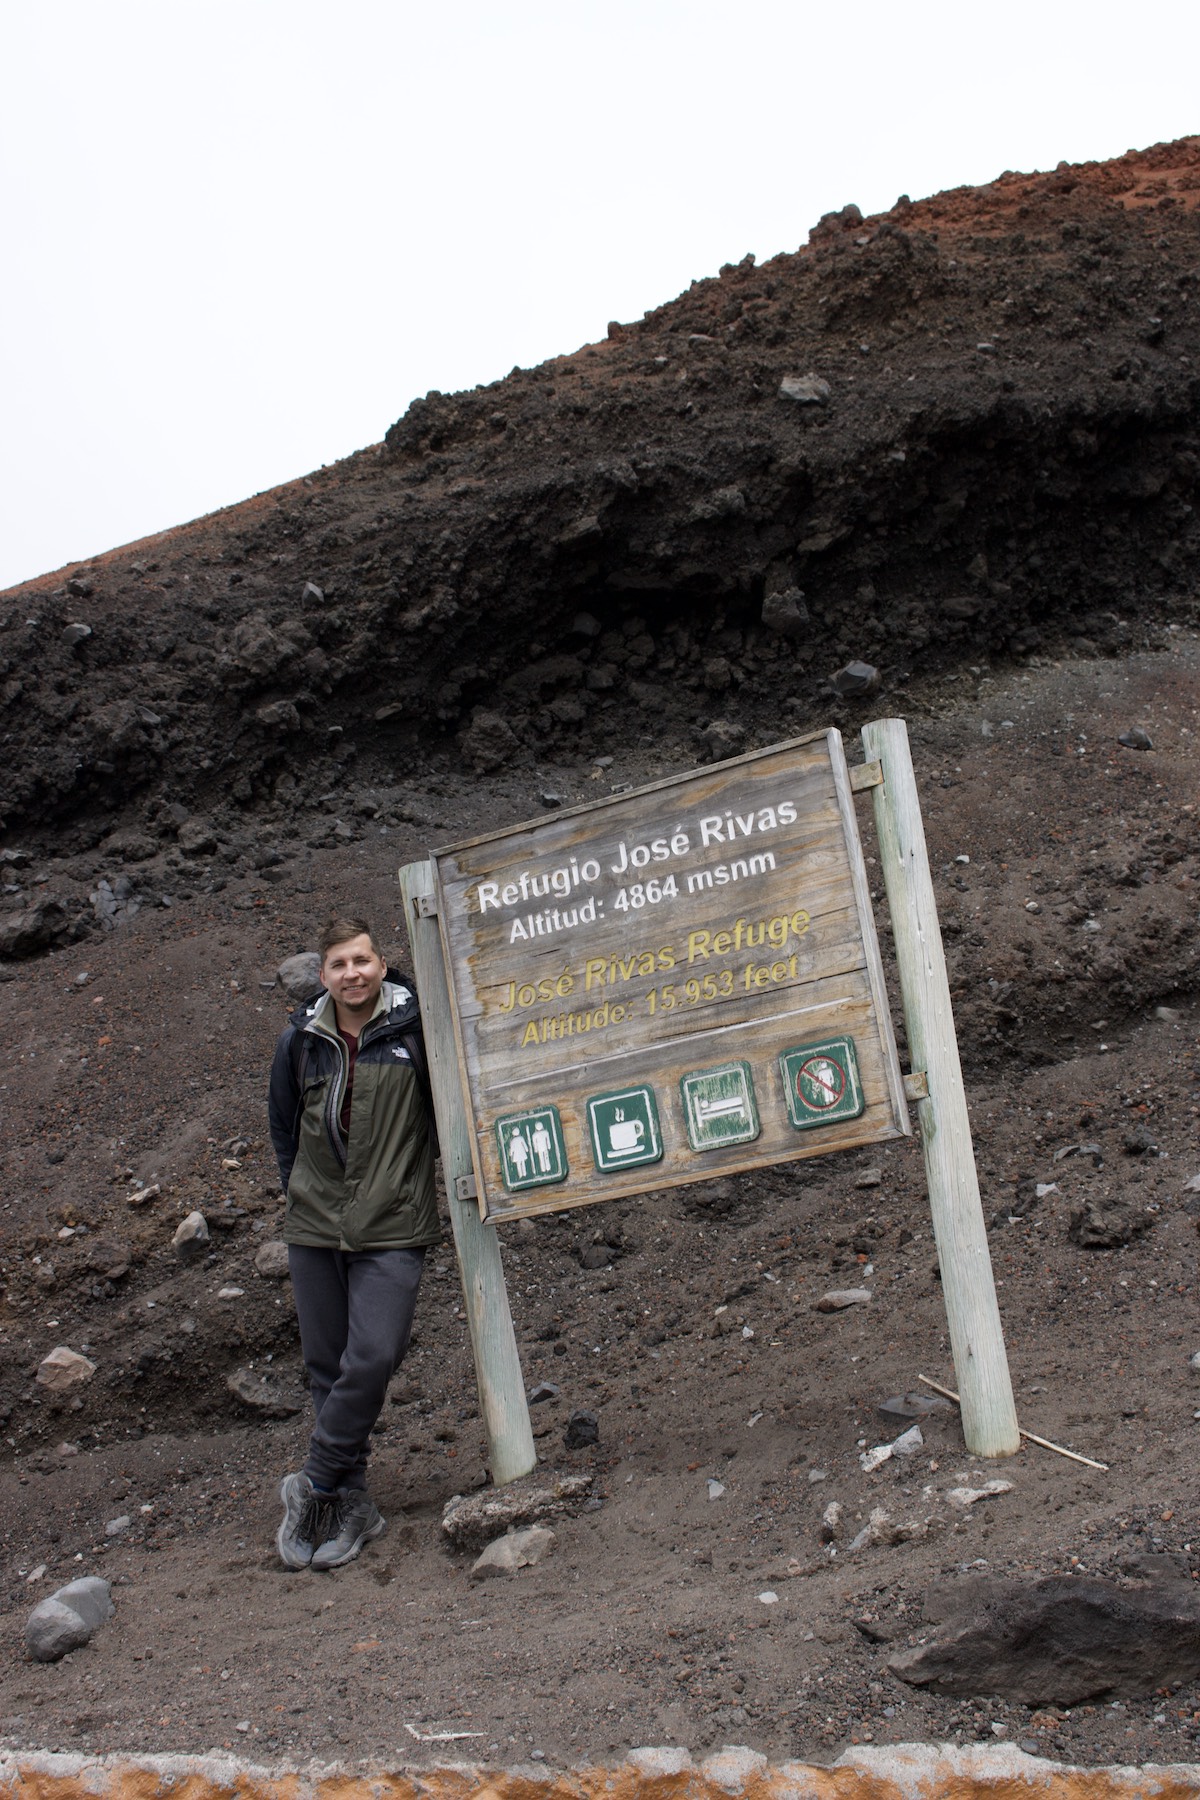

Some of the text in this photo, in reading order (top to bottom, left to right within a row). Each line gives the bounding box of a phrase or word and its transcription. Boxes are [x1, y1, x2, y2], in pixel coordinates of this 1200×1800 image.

[477, 800, 798, 913] Refugio José Rivas
[509, 851, 777, 943] Altitud: 4864 msnm
[499, 909, 811, 1014] José Rivas Refuge
[520, 954, 799, 1048] Altitude: 15.953 feet
